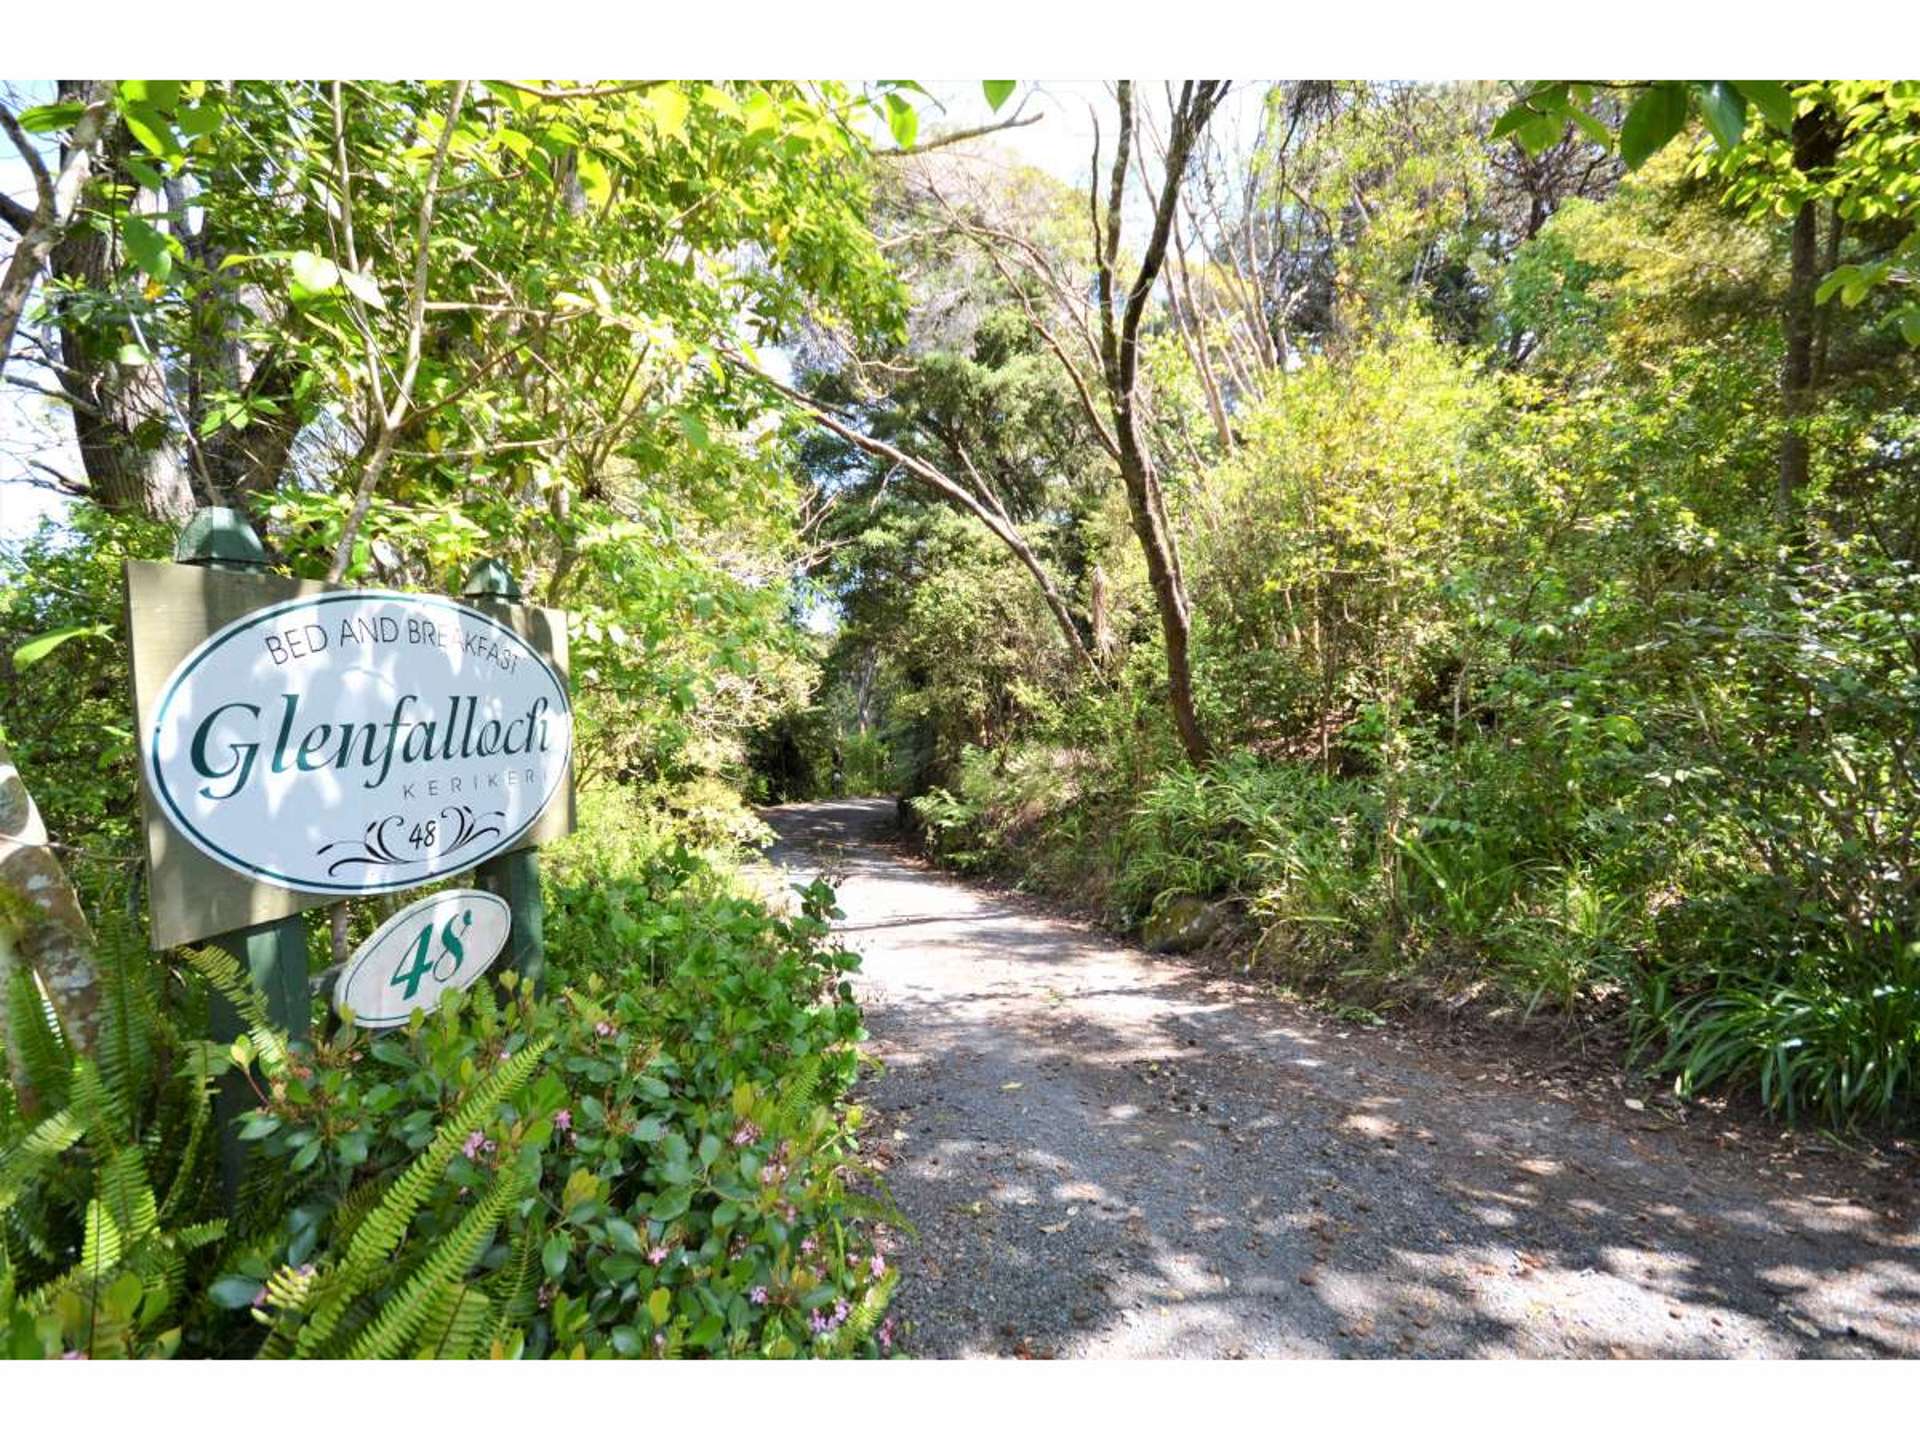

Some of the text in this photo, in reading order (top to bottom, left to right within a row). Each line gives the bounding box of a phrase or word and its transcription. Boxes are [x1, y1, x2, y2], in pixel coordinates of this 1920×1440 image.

[265, 617, 518, 673] BED AND BREAKFAST
[189, 693, 549, 800] Glenfalloch
[402, 768, 547, 799] KERIKERI
[408, 820, 437, 849] 48
[390, 909, 472, 1000] 48
